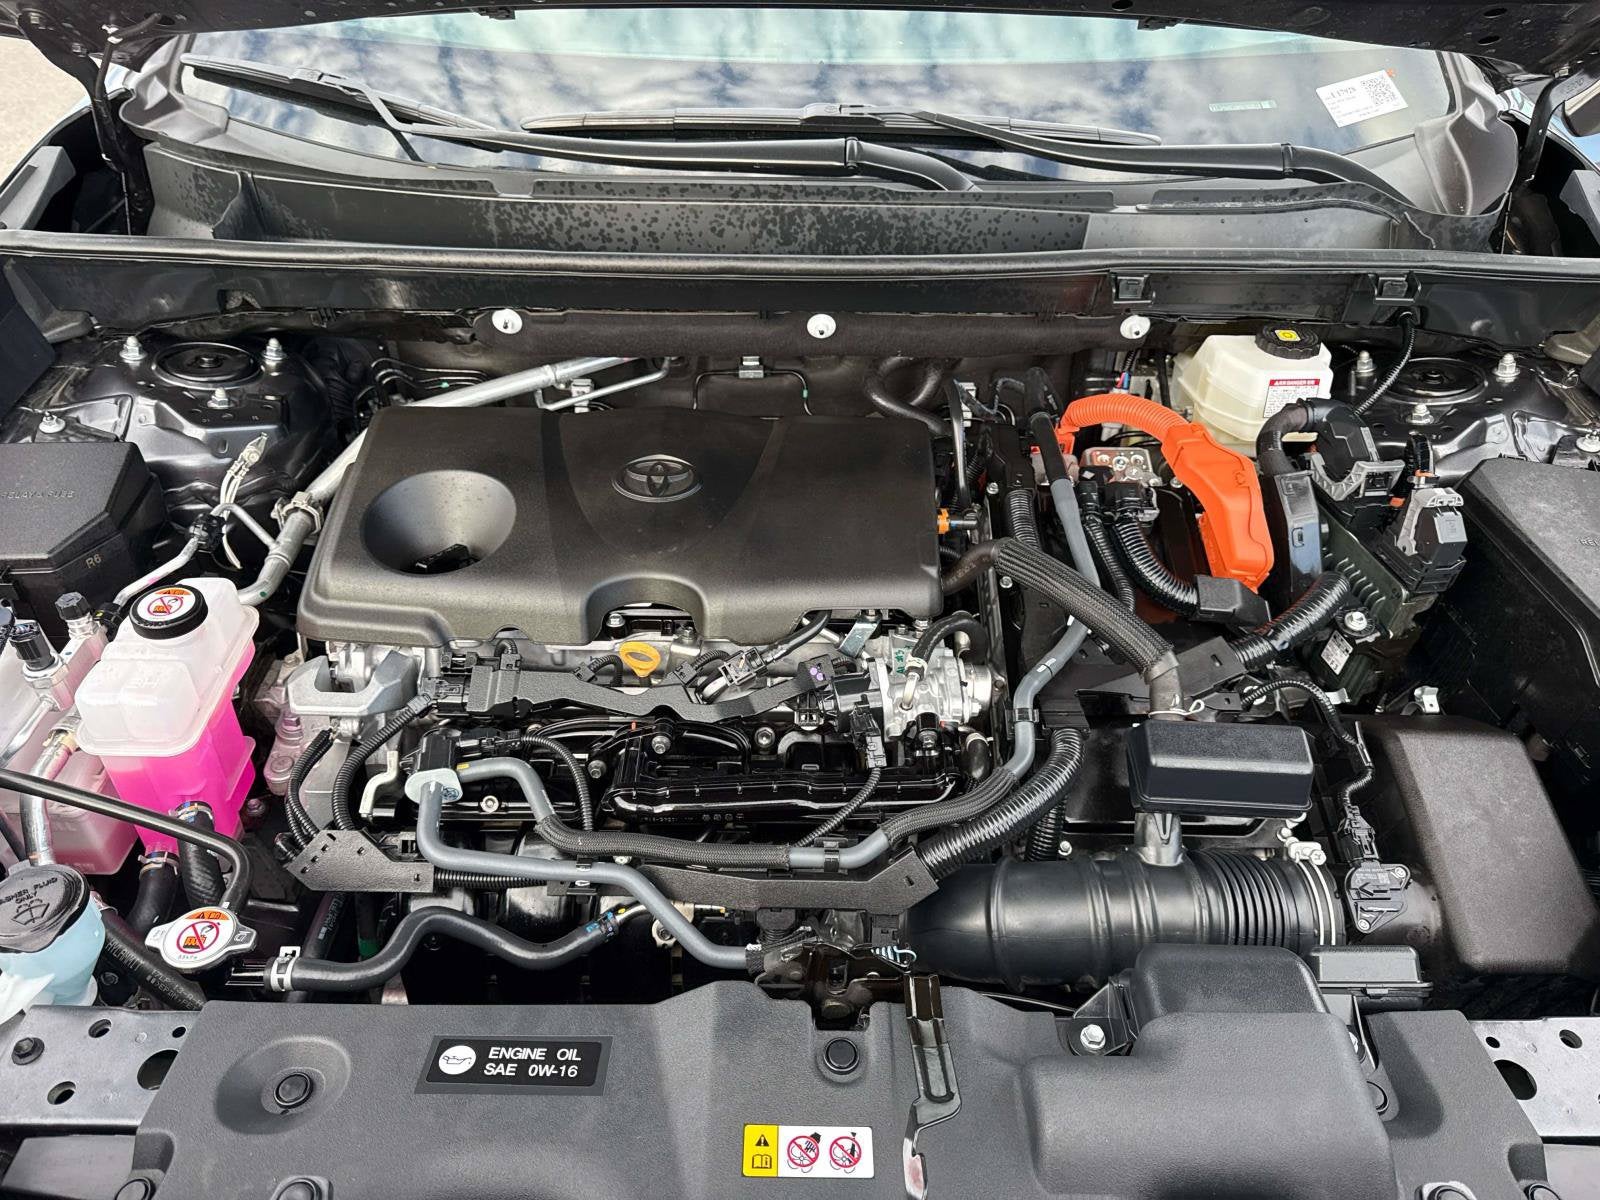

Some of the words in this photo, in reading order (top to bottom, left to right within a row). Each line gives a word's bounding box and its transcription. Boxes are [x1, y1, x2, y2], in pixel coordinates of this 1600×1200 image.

[85, 553, 101, 569] R6
[33, 877, 58, 890] FLUID
[15, 890, 38, 904] ONLY
[488, 1047, 547, 1061] ENGINE
[556, 1048, 582, 1061] OIL
[483, 1063, 518, 1076] SAE
[528, 1064, 578, 1078] 0W-16
